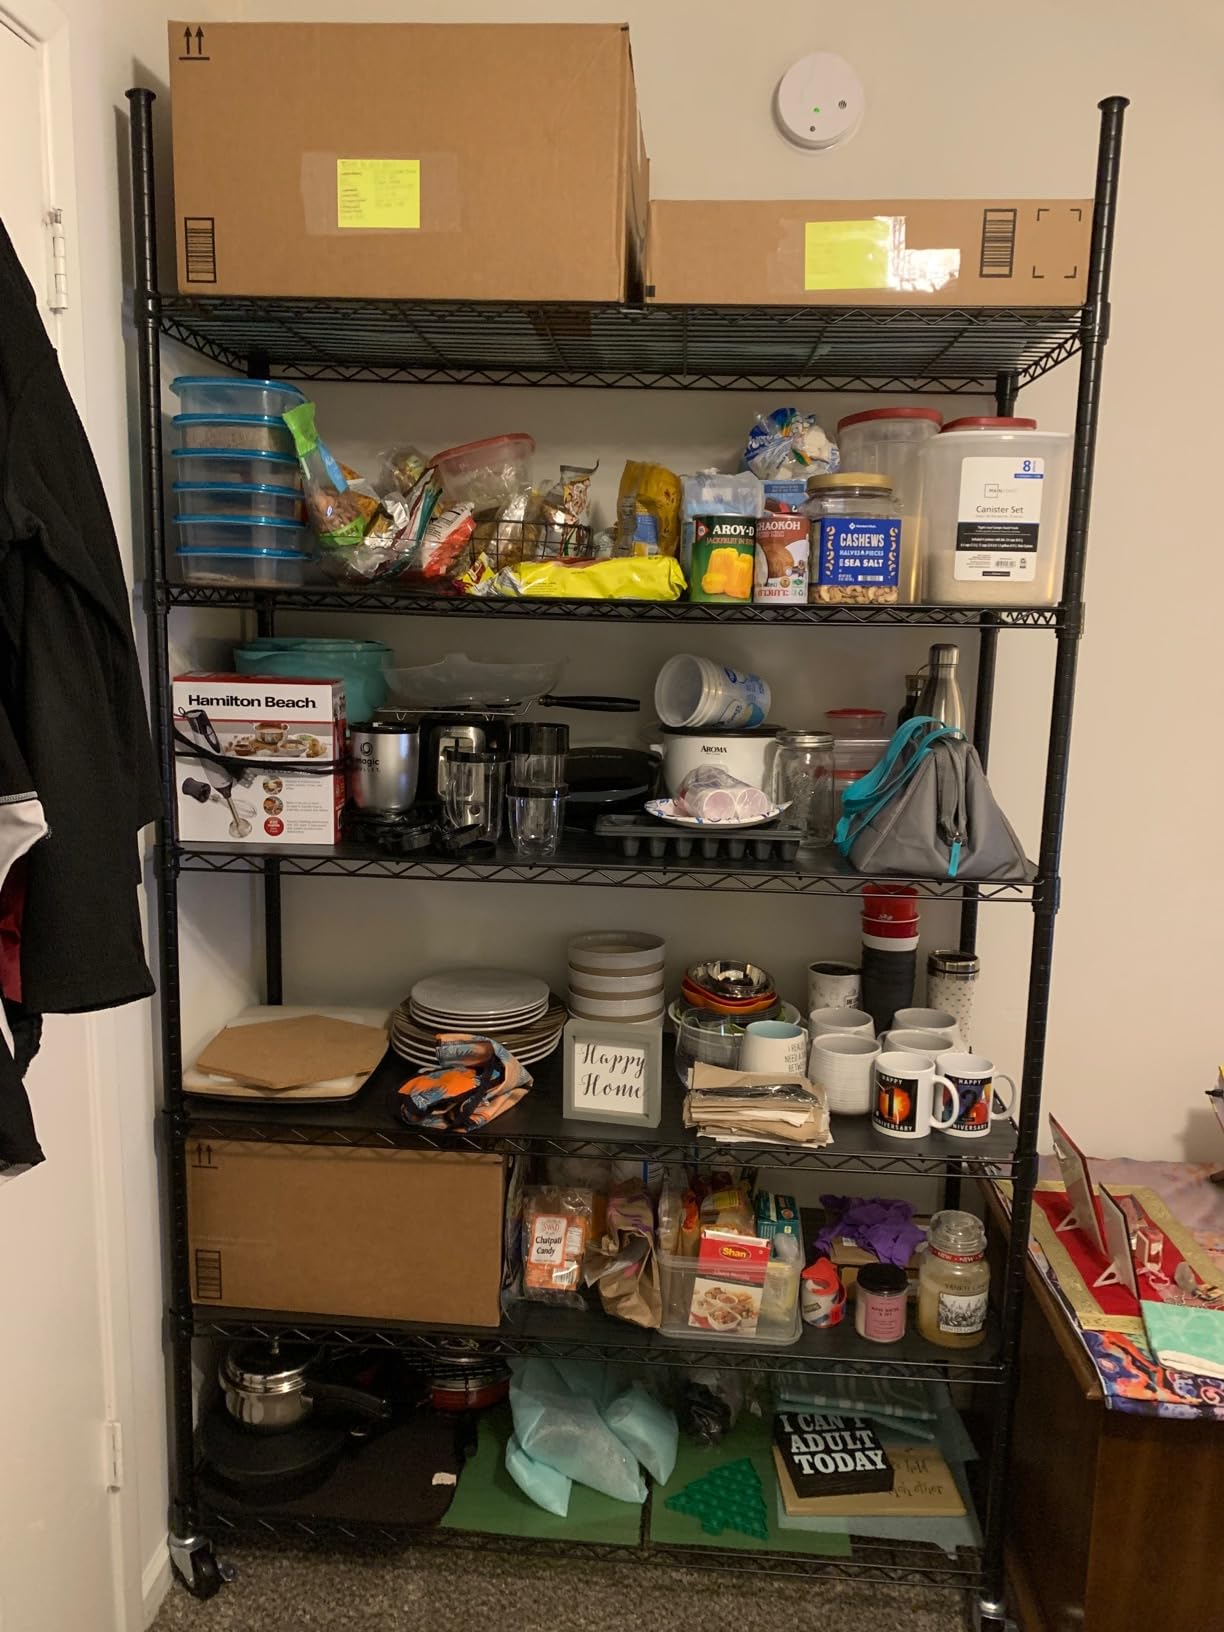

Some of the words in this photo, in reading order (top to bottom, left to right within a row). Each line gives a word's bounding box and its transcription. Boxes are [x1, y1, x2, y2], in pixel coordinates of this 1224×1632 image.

[1023, 460, 1031, 472] 8
[976, 505, 1009, 513] Canister
[1011, 505, 1024, 513] Set
[713, 524, 754, 536] AROY-D
[840, 533, 885, 547] CASHEWS
[844, 558, 861, 567] SEA
[863, 559, 884, 567] SALT
[188, 694, 261, 708] Hamilton
[265, 696, 316, 709] Beach
[701, 745, 728, 754] AROMA
[577, 1043, 646, 1079] Happy
[577, 1072, 643, 1099] Home
[882, 1075, 903, 1085] HAPPY
[952, 1123, 987, 1131] NIVERSARY
[535, 1236, 562, 1246] Chatpati
[536, 1248, 556, 1257] Candy
[722, 1246, 747, 1258] Shan
[791, 1430, 875, 1453] ADULT
[793, 1450, 887, 1474] TODAY
